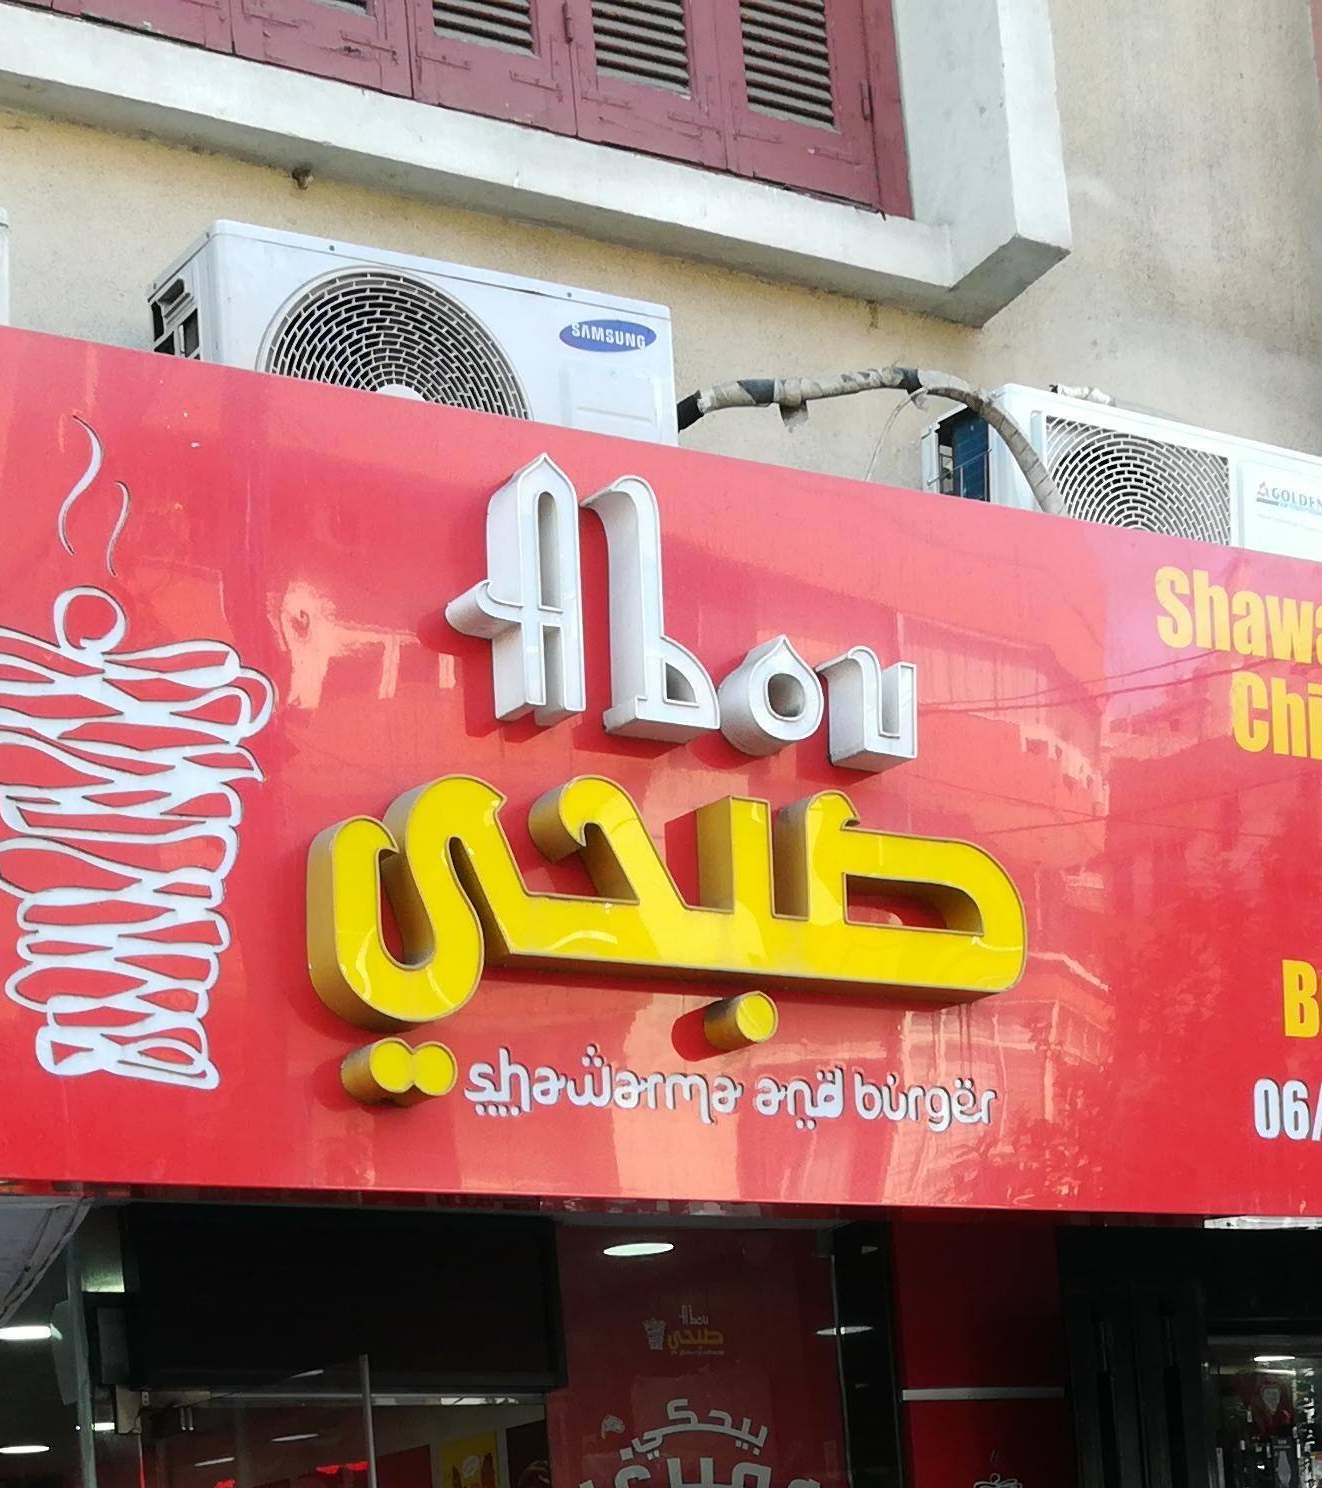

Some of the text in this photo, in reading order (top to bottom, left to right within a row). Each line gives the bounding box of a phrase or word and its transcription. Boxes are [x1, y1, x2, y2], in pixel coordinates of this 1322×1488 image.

[570, 320, 647, 349] SAMSUNG
[445, 452, 918, 773] Abou
[306, 774, 1026, 1097] صبحي
[463, 1045, 999, 1133] shawarma and burger
[630, 1398, 769, 1460] بيحكي
